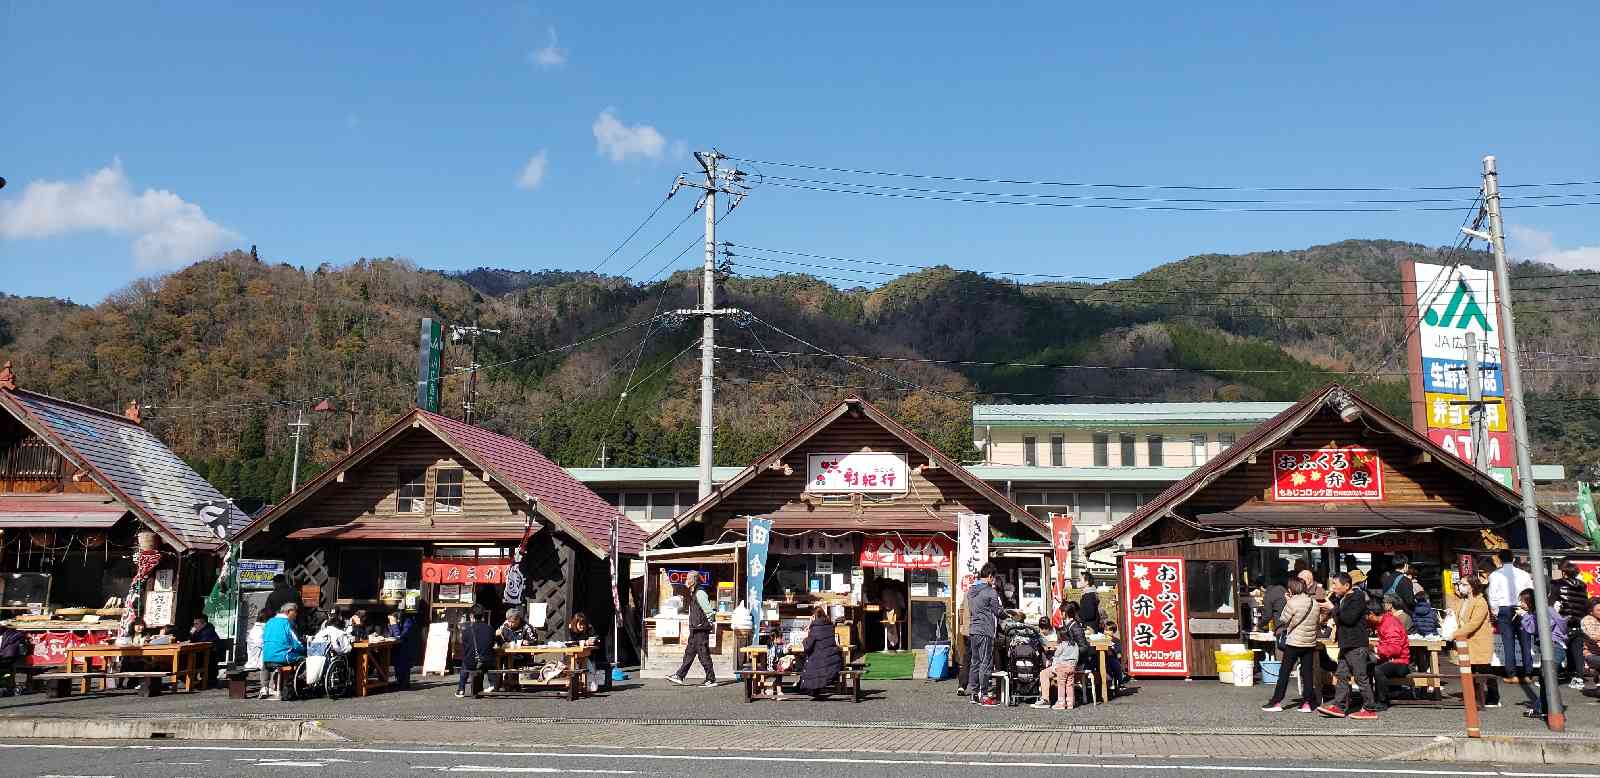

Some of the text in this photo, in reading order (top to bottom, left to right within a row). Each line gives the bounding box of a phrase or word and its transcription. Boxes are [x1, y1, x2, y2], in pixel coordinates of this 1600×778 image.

[1431, 361, 1496, 391] 生鮮食品
[1279, 452, 1348, 470] おふくろ
[1324, 470, 1372, 488] 弁当
[1156, 564, 1179, 640] おふくろ
[1132, 594, 1157, 647] 弁当
